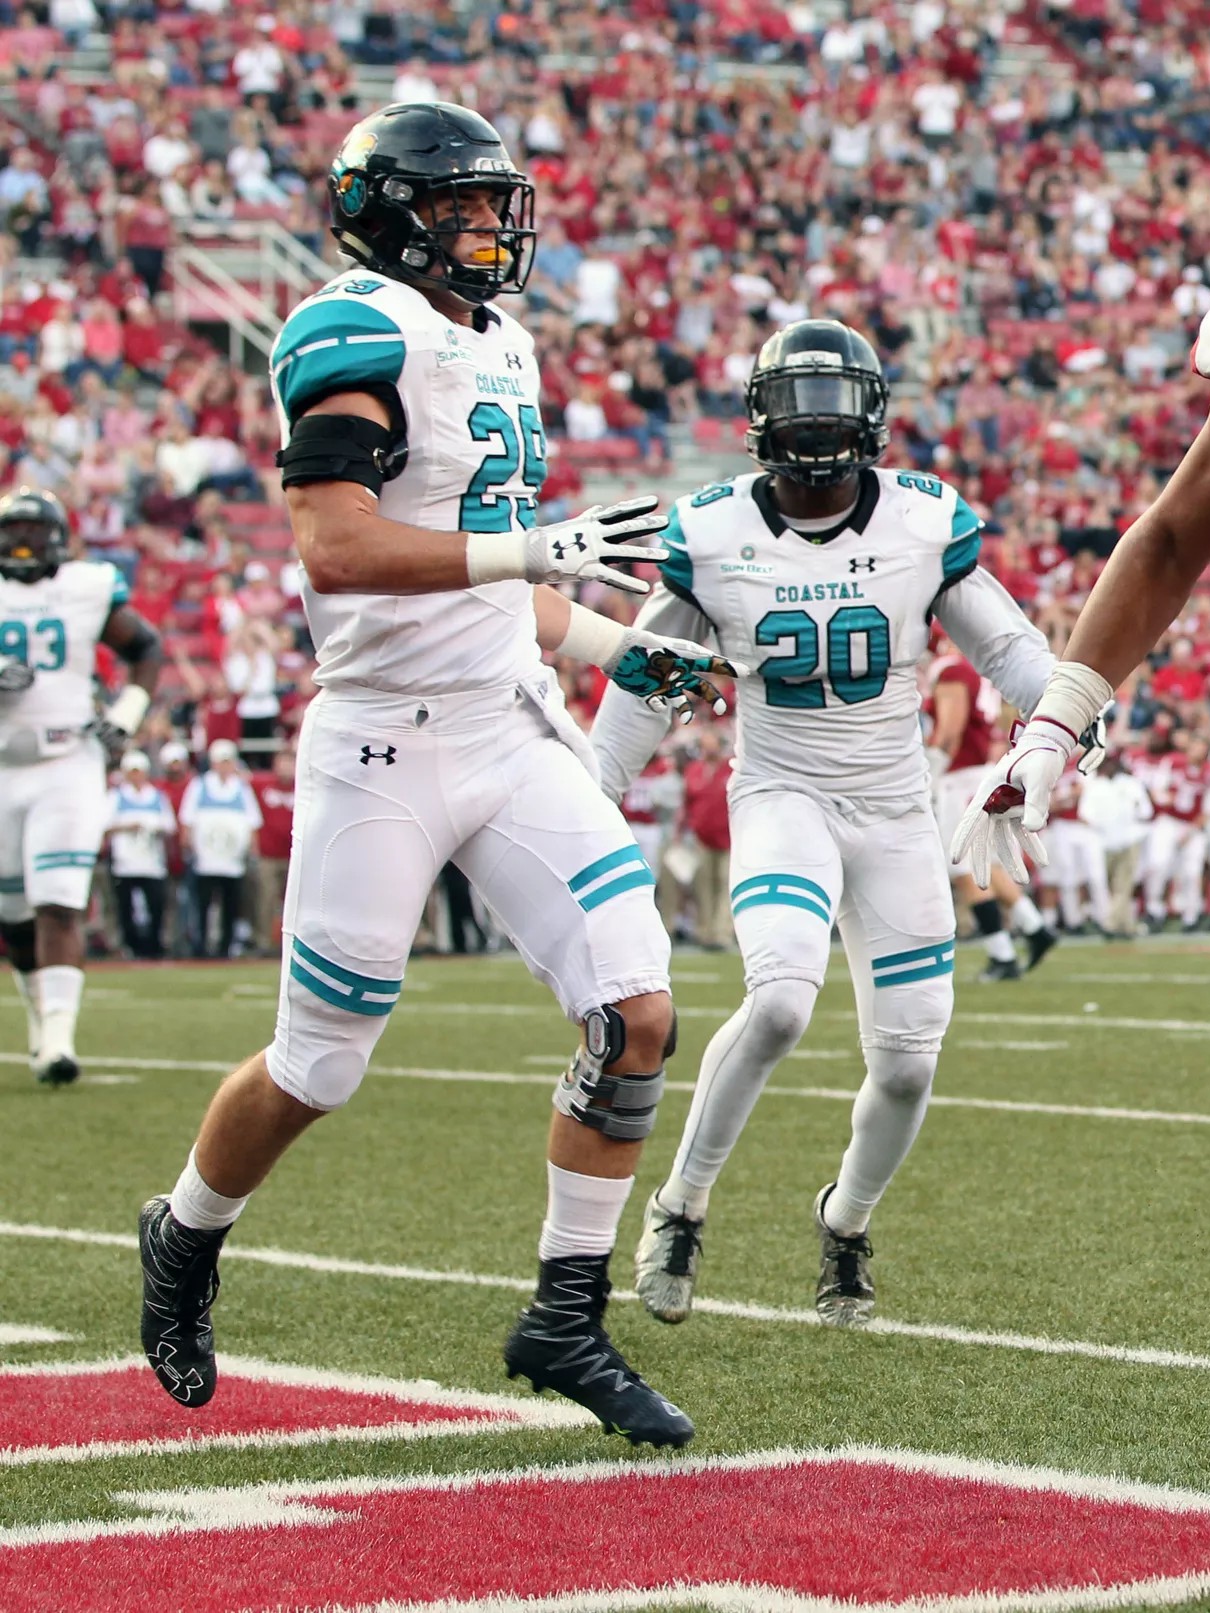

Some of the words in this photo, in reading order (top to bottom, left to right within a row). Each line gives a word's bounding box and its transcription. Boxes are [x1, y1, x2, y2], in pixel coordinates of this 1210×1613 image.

[475, 373, 525, 397] COASTAL
[775, 582, 865, 603] COASTAL
[0, 618, 66, 671] 93
[755, 605, 891, 709] 20
